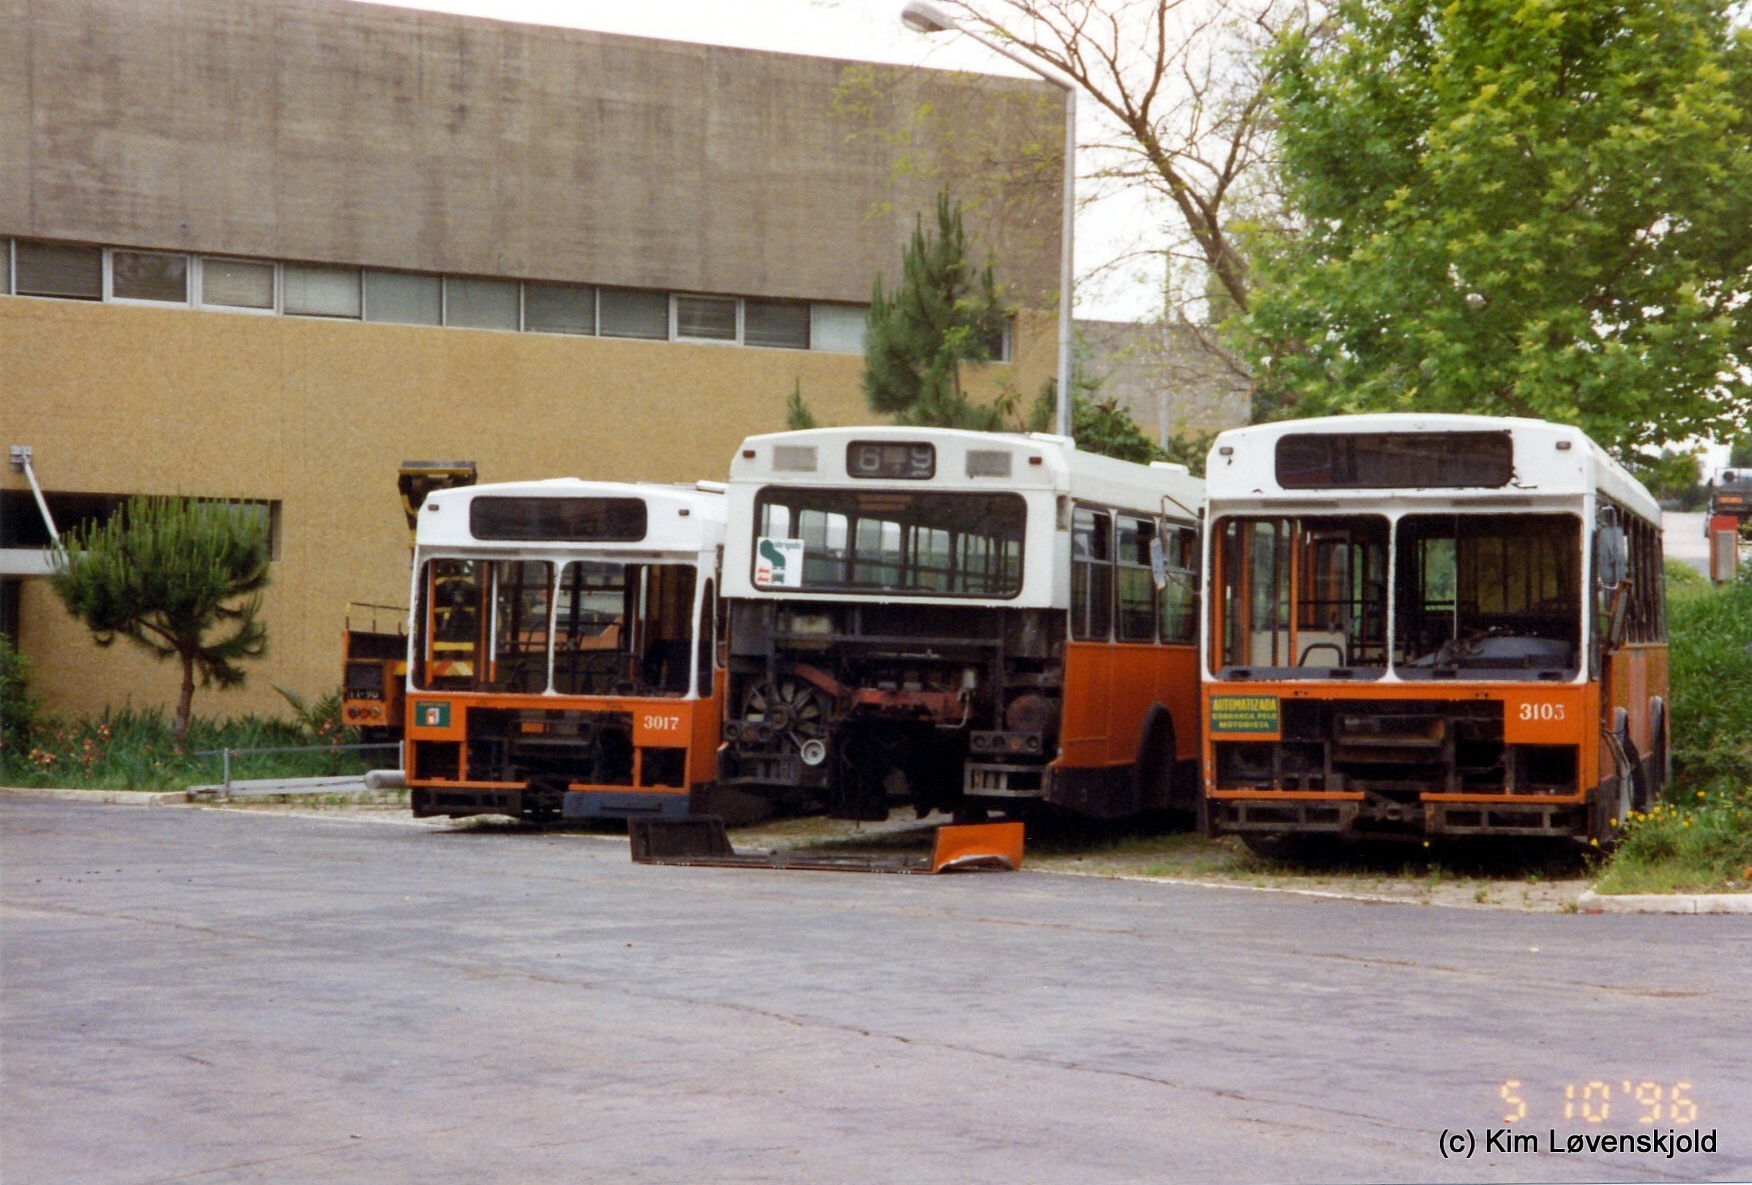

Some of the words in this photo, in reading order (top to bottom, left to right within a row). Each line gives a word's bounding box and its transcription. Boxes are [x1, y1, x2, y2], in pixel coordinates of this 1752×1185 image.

[1212, 698, 1277, 711] AUTOMATIZADA
[1519, 703, 1565, 720] 3105
[643, 715, 680, 730] 3017
